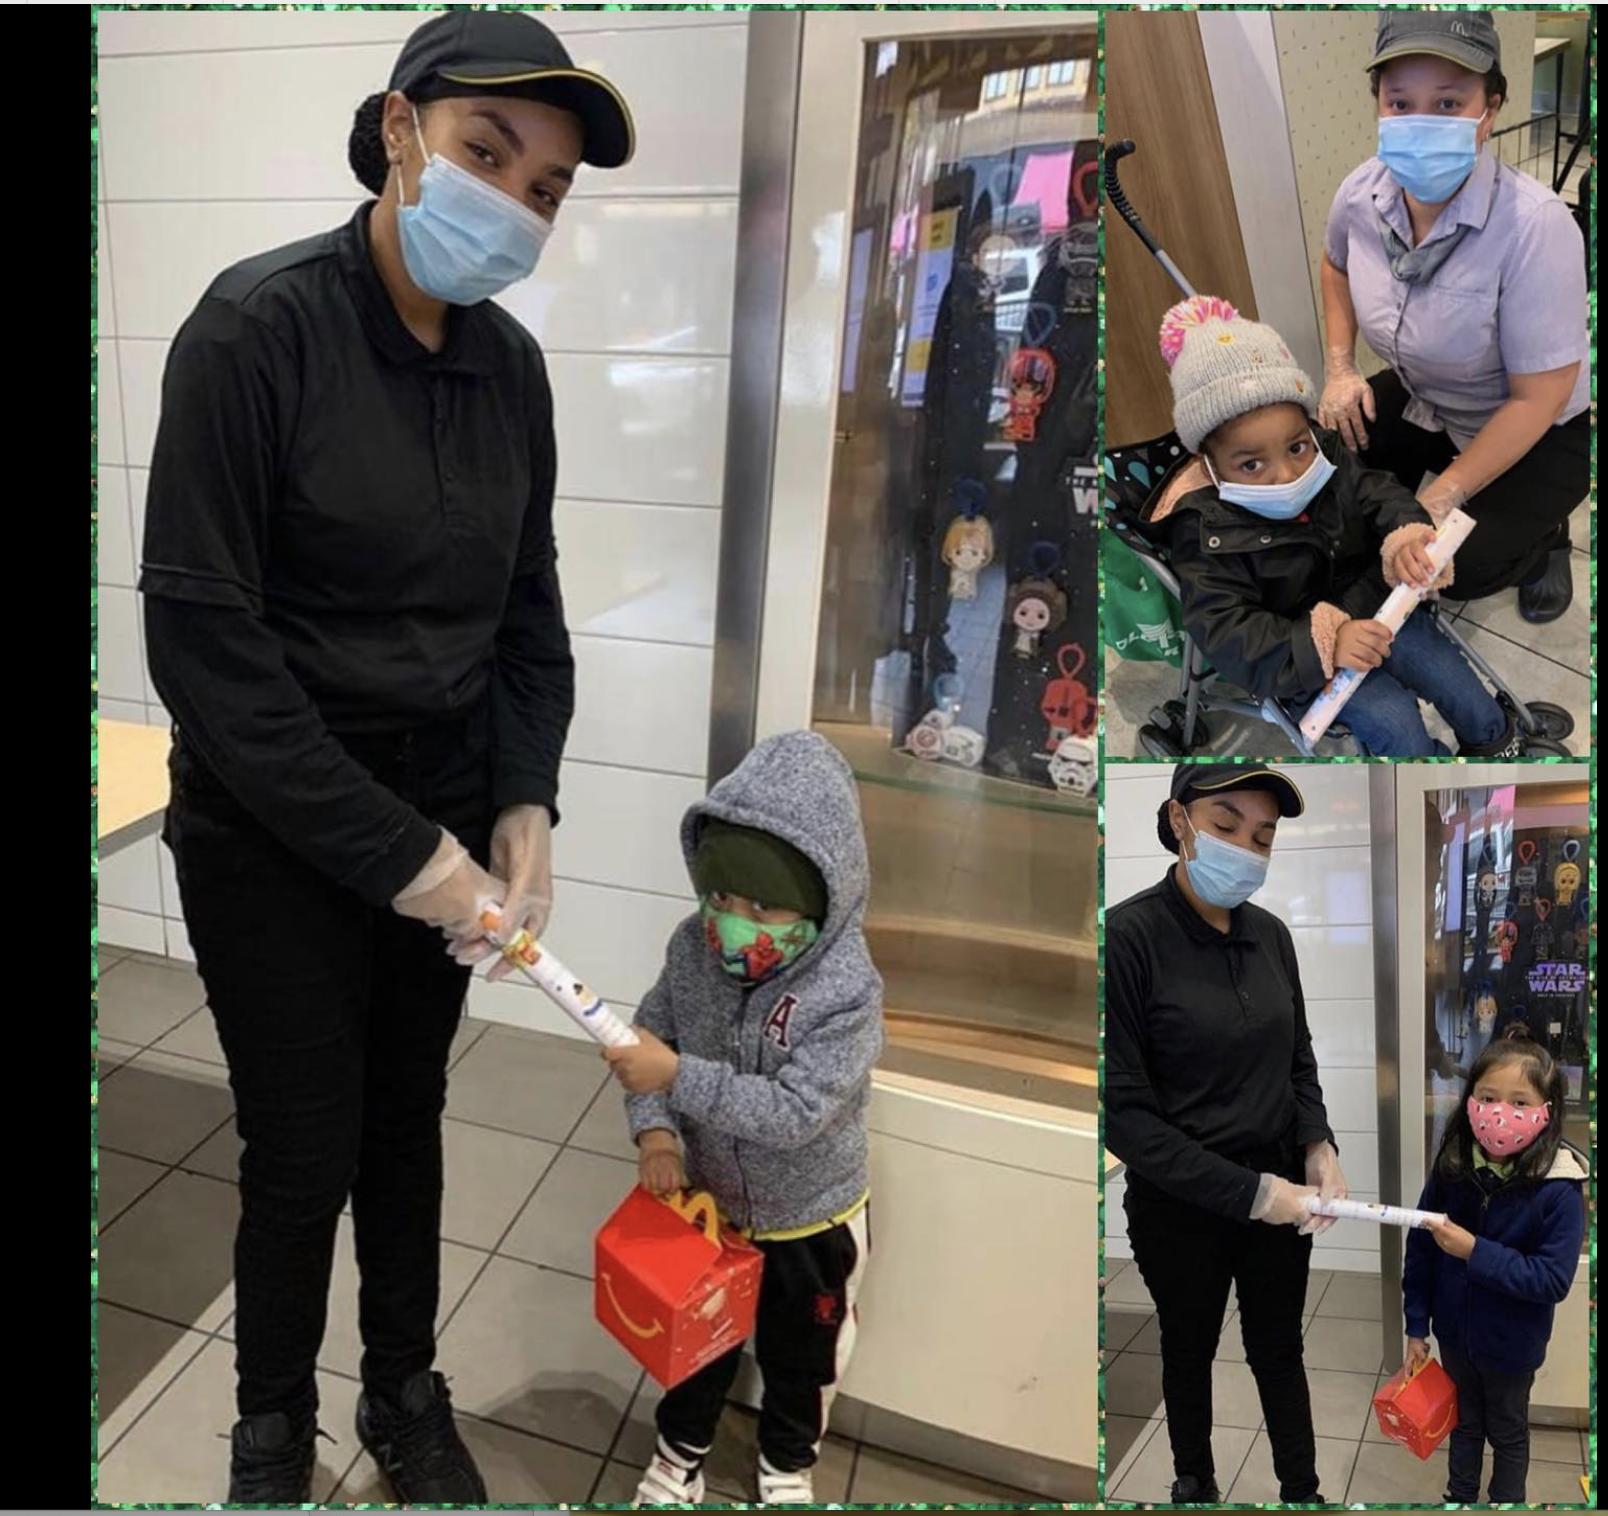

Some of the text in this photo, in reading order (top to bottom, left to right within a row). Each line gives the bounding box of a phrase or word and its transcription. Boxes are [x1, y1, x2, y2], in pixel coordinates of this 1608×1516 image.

[1528, 963, 1586, 976] STAR
[1529, 979, 1585, 992] WARS
[762, 992, 800, 1052] A
